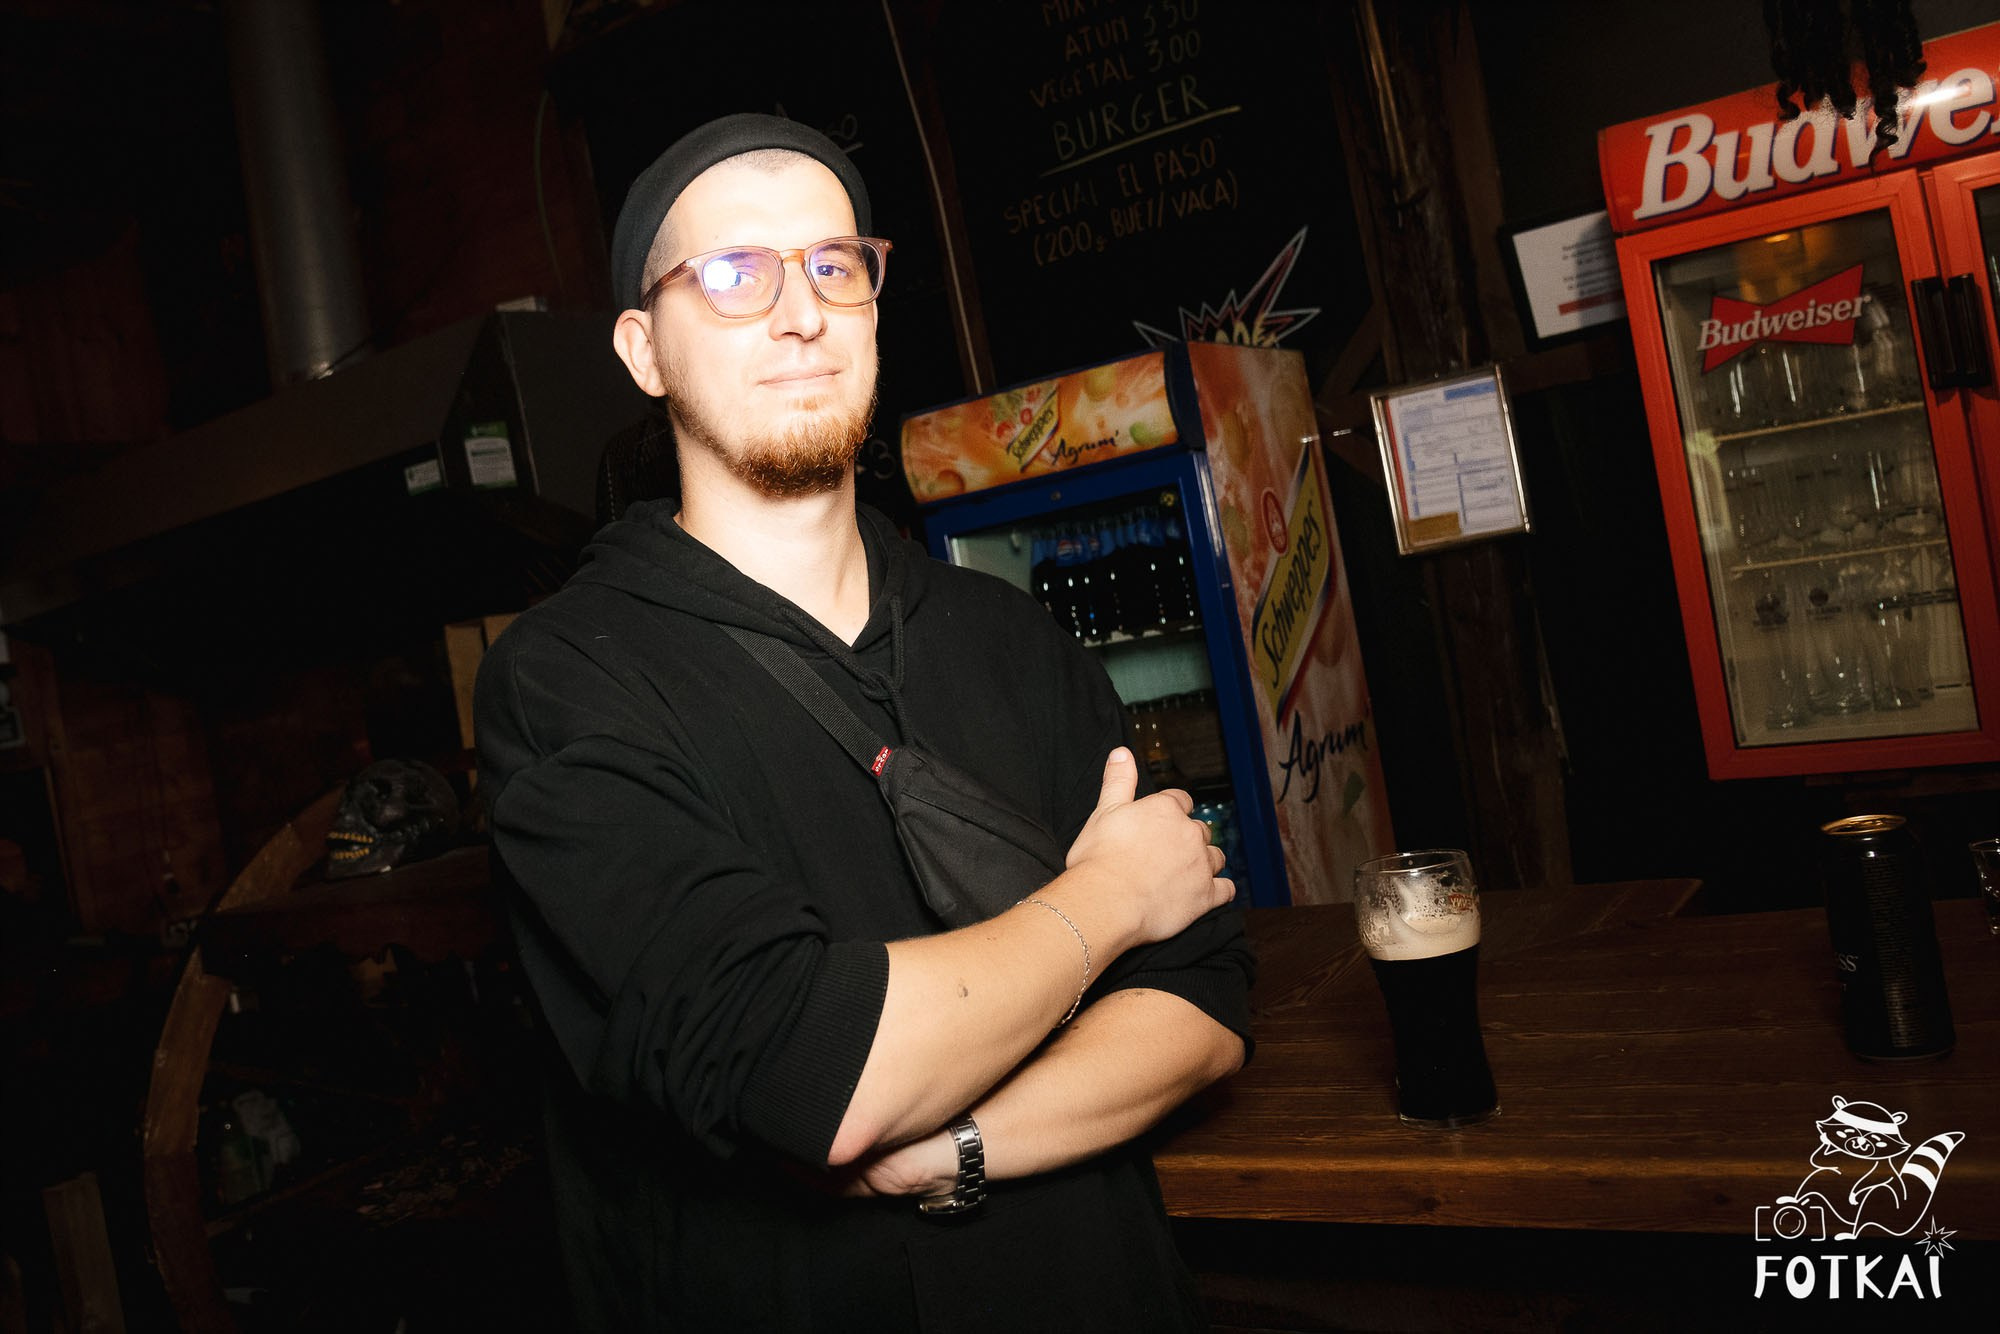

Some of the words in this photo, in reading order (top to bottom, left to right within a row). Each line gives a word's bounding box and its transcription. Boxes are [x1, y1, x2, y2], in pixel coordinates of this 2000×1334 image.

[1053, 74, 1209, 161] BURGER
[1632, 64, 2000, 220] Budwe
[1116, 161, 1144, 199] EL
[1153, 136, 1216, 186] PASO
[1697, 296, 1864, 350] Budweiser
[1261, 499, 1321, 688] Schweppes
